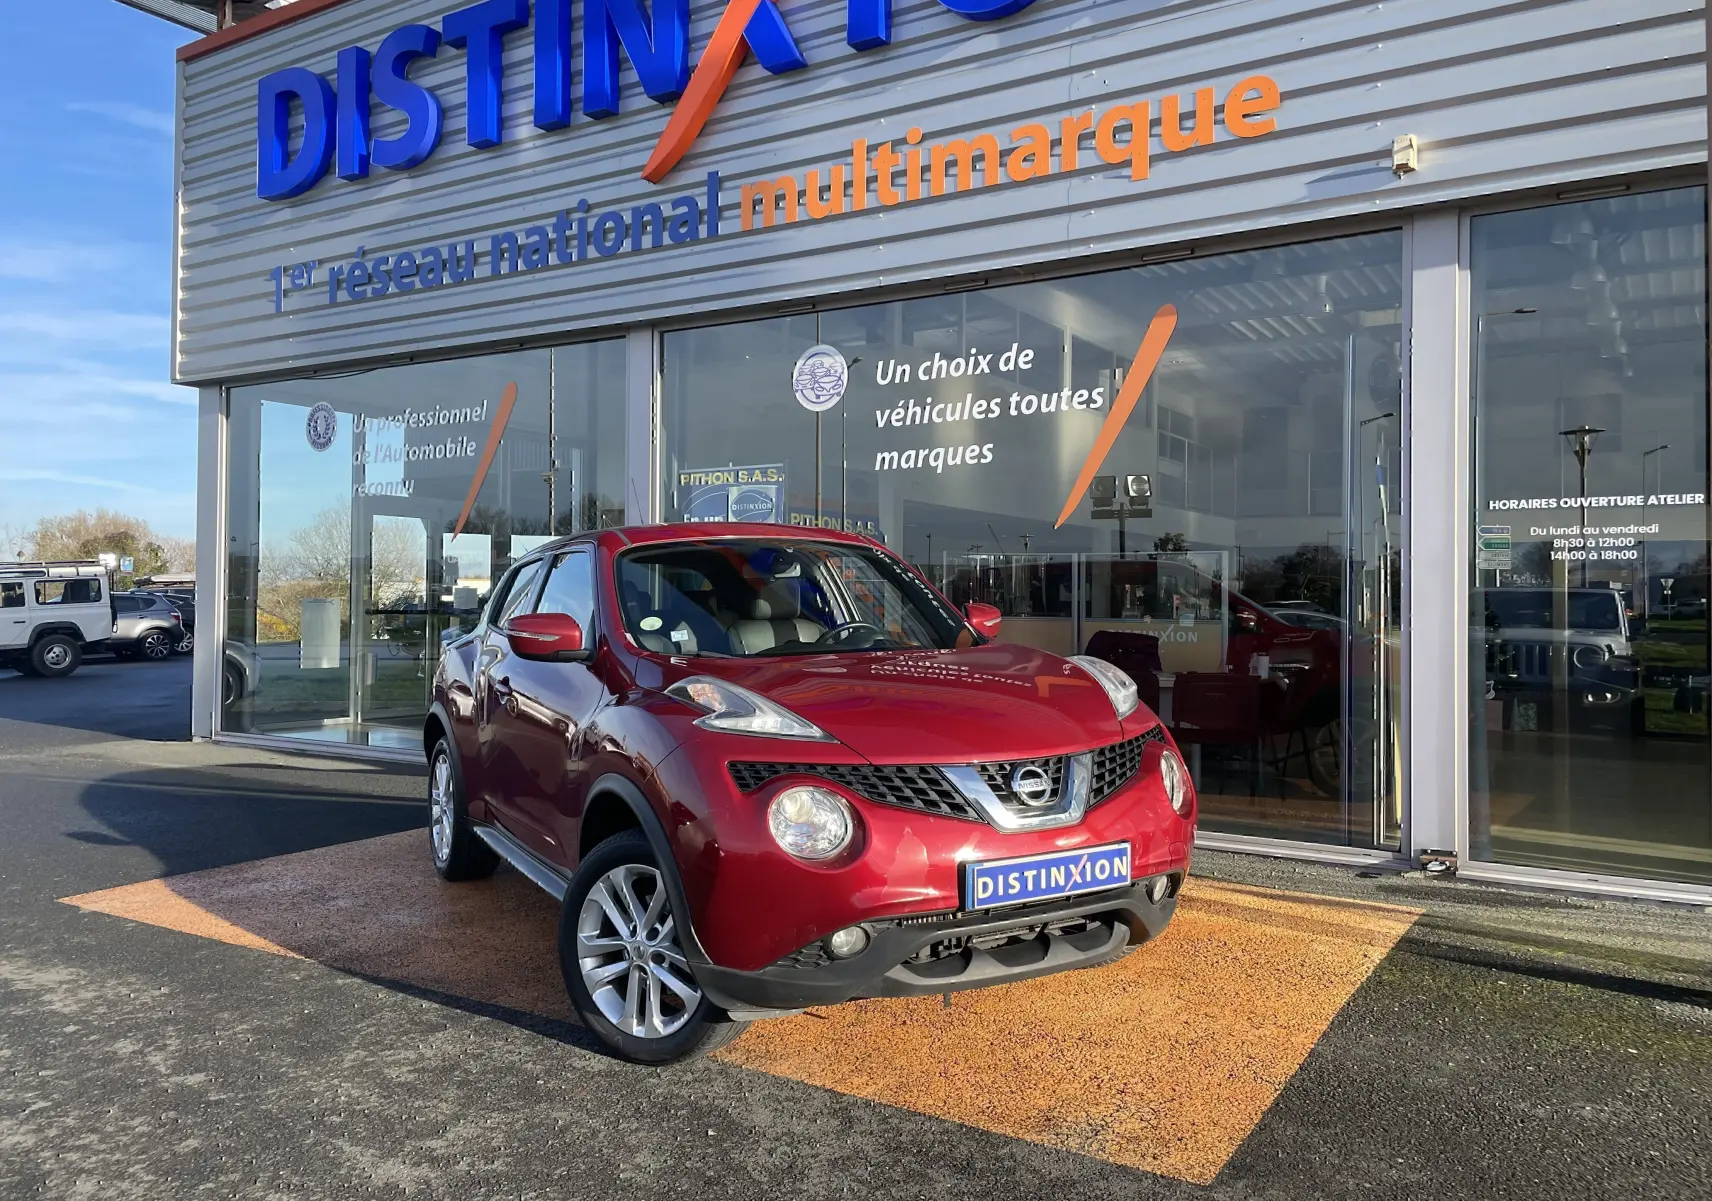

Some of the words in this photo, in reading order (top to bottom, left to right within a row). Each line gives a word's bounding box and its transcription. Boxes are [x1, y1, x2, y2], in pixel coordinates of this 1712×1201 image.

[269, 256, 318, 313] 1er
[328, 241, 475, 304] réseau
[489, 170, 723, 276] national
[740, 74, 1281, 231] multimarque
[876, 359, 911, 386] Un
[918, 347, 993, 382] choix
[998, 342, 1035, 372] de
[875, 393, 1002, 428] véhicules
[1008, 386, 1104, 416] toutes
[353, 413, 373, 433] Un
[377, 399, 488, 437] professionnel
[352, 445, 370, 465] de
[374, 436, 477, 464] l'Automobile
[874, 442, 994, 474] marques
[680, 472, 734, 487] PITHON
[738, 469, 784, 484] S.A.S.
[352, 479, 415, 498] reconnu
[732, 500, 772, 512] DISTINXION
[1489, 498, 1558, 511] HORAIRES
[1560, 495, 1645, 509] OUVERTURE
[1647, 493, 1705, 506] ATELIER
[791, 512, 841, 531] PITHON
[1530, 526, 1546, 536] Du
[1549, 525, 1580, 536] lundi
[1583, 527, 1599, 535] au
[1602, 524, 1659, 535] vendredi
[1553, 537, 1584, 548] 8h30
[1587, 537, 1595, 547] à
[1598, 537, 1635, 548] 12h00
[1550, 550, 1586, 561] 14h00
[1589, 550, 1598, 560] à
[1600, 550, 1638, 561] 18h00
[1018, 778, 1050, 790] NISSAN
[976, 853, 1128, 900] DISTINXION
